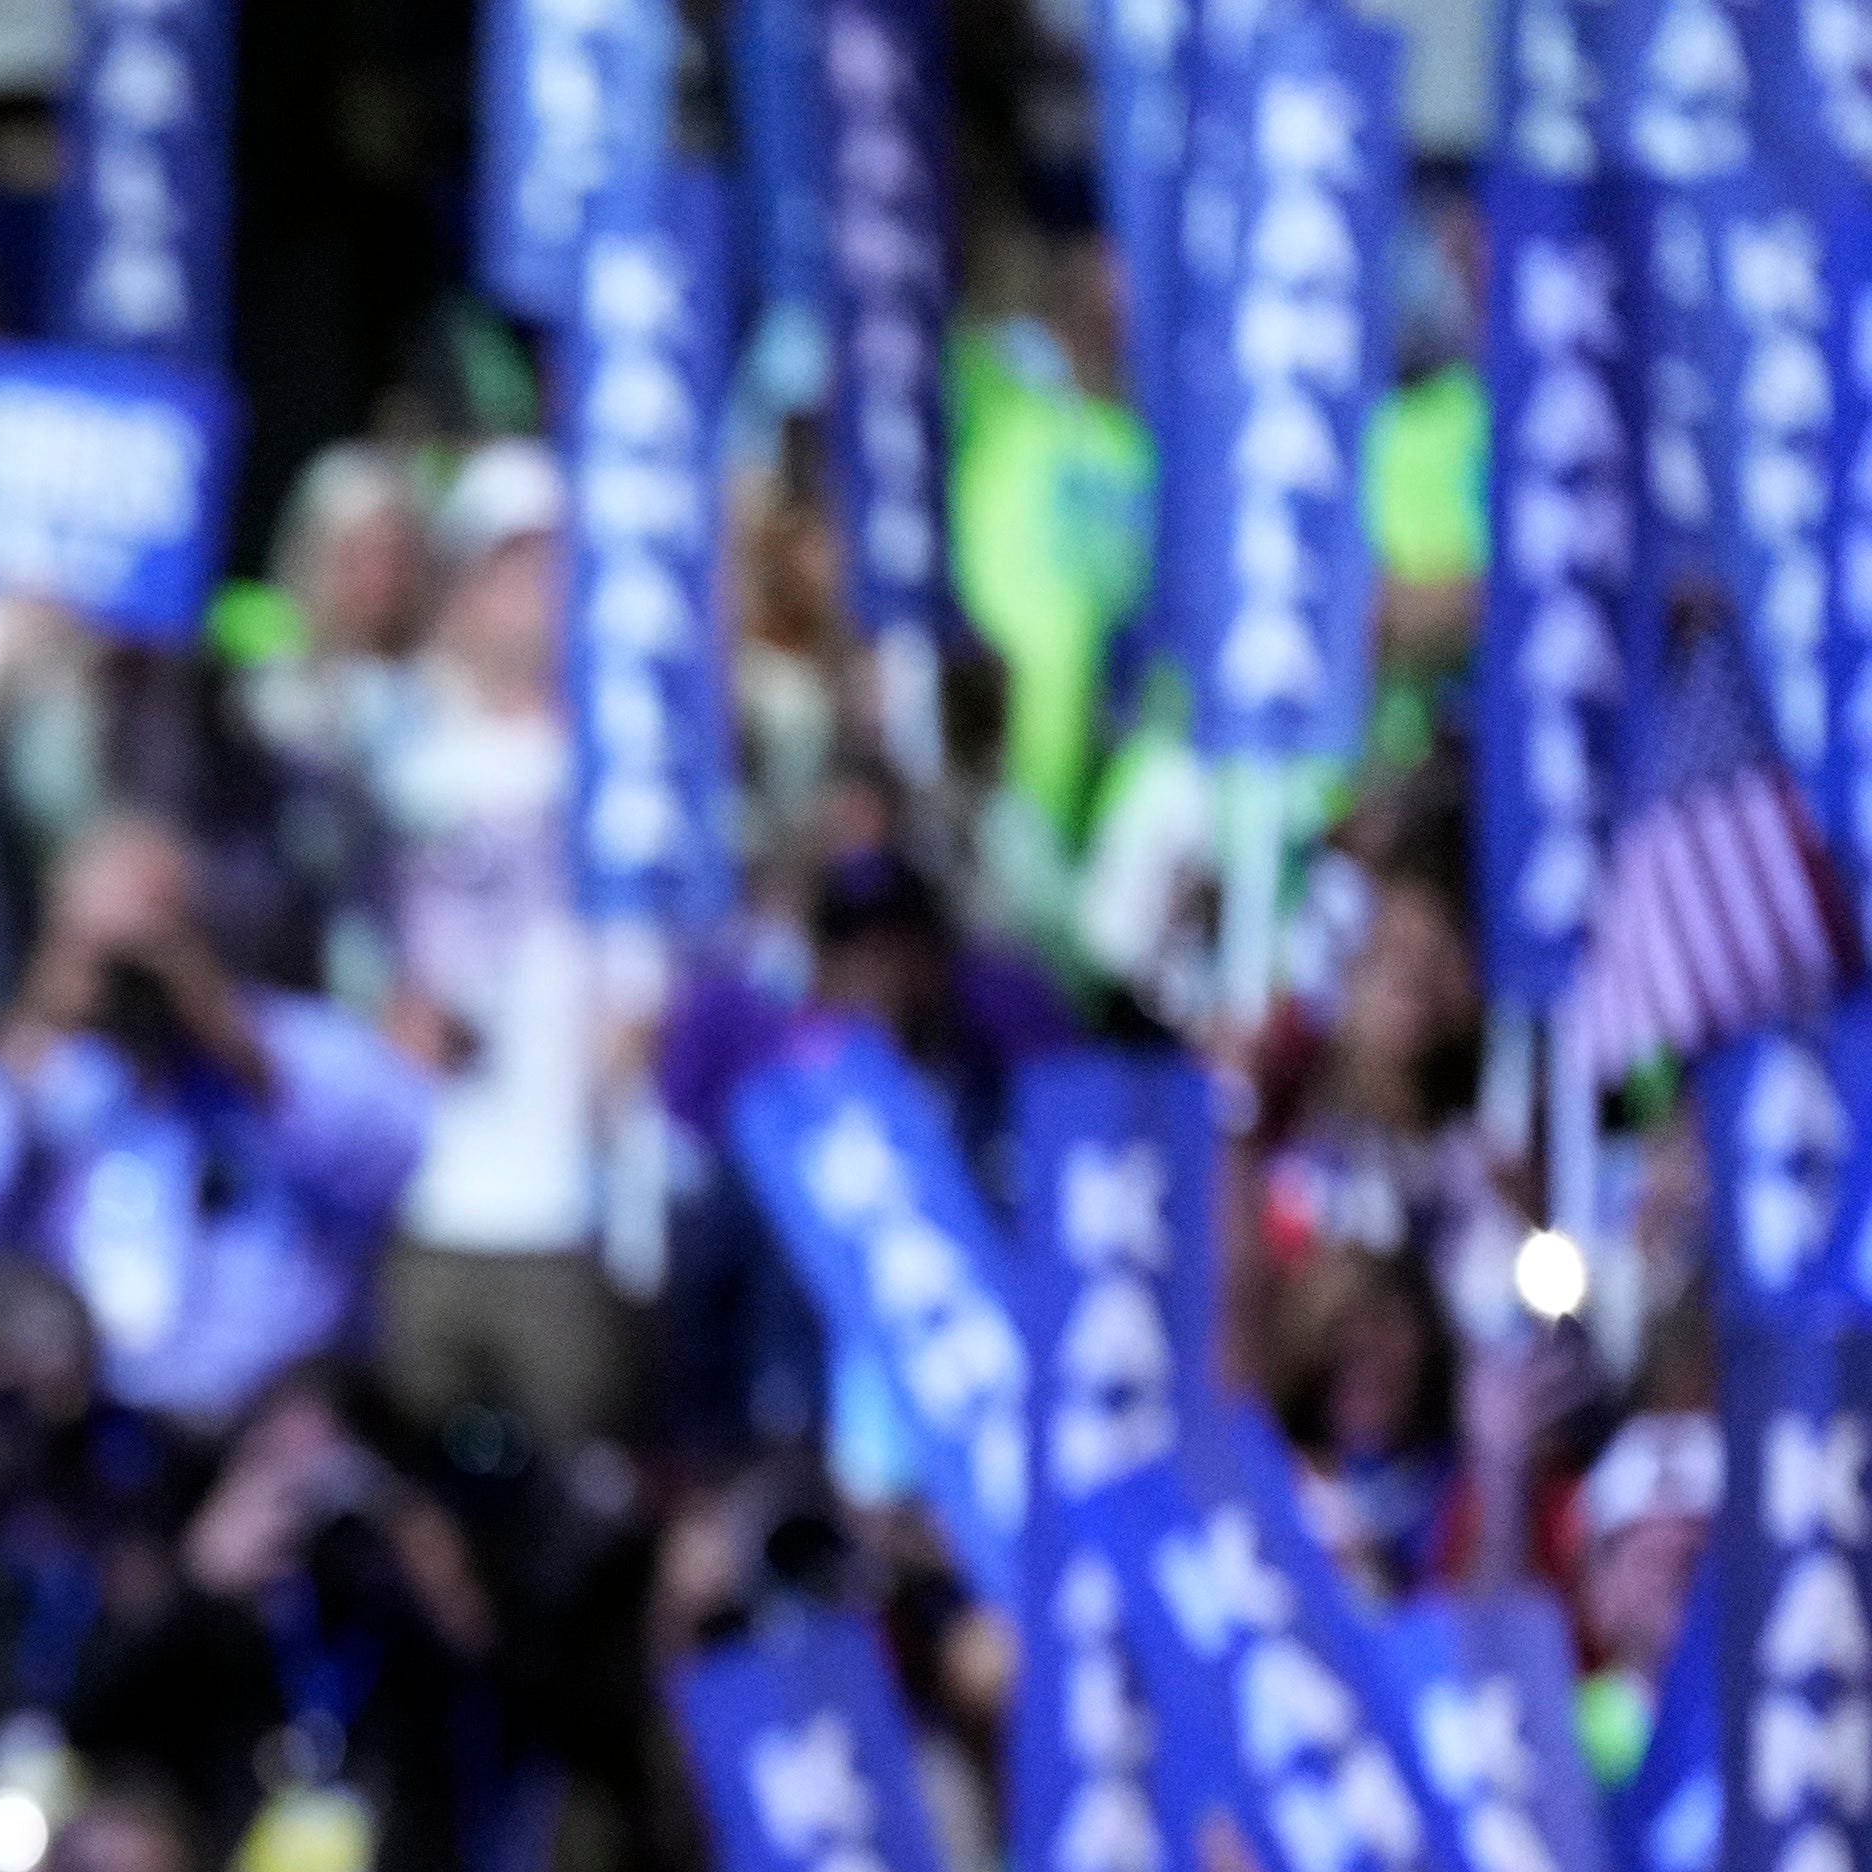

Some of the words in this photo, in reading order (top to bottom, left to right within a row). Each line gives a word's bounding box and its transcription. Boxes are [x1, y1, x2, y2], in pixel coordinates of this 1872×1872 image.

[581, 232, 696, 872] KAMALA
[1216, 70, 1366, 710] KAMALA
[1514, 238, 1626, 938] KAMALA
